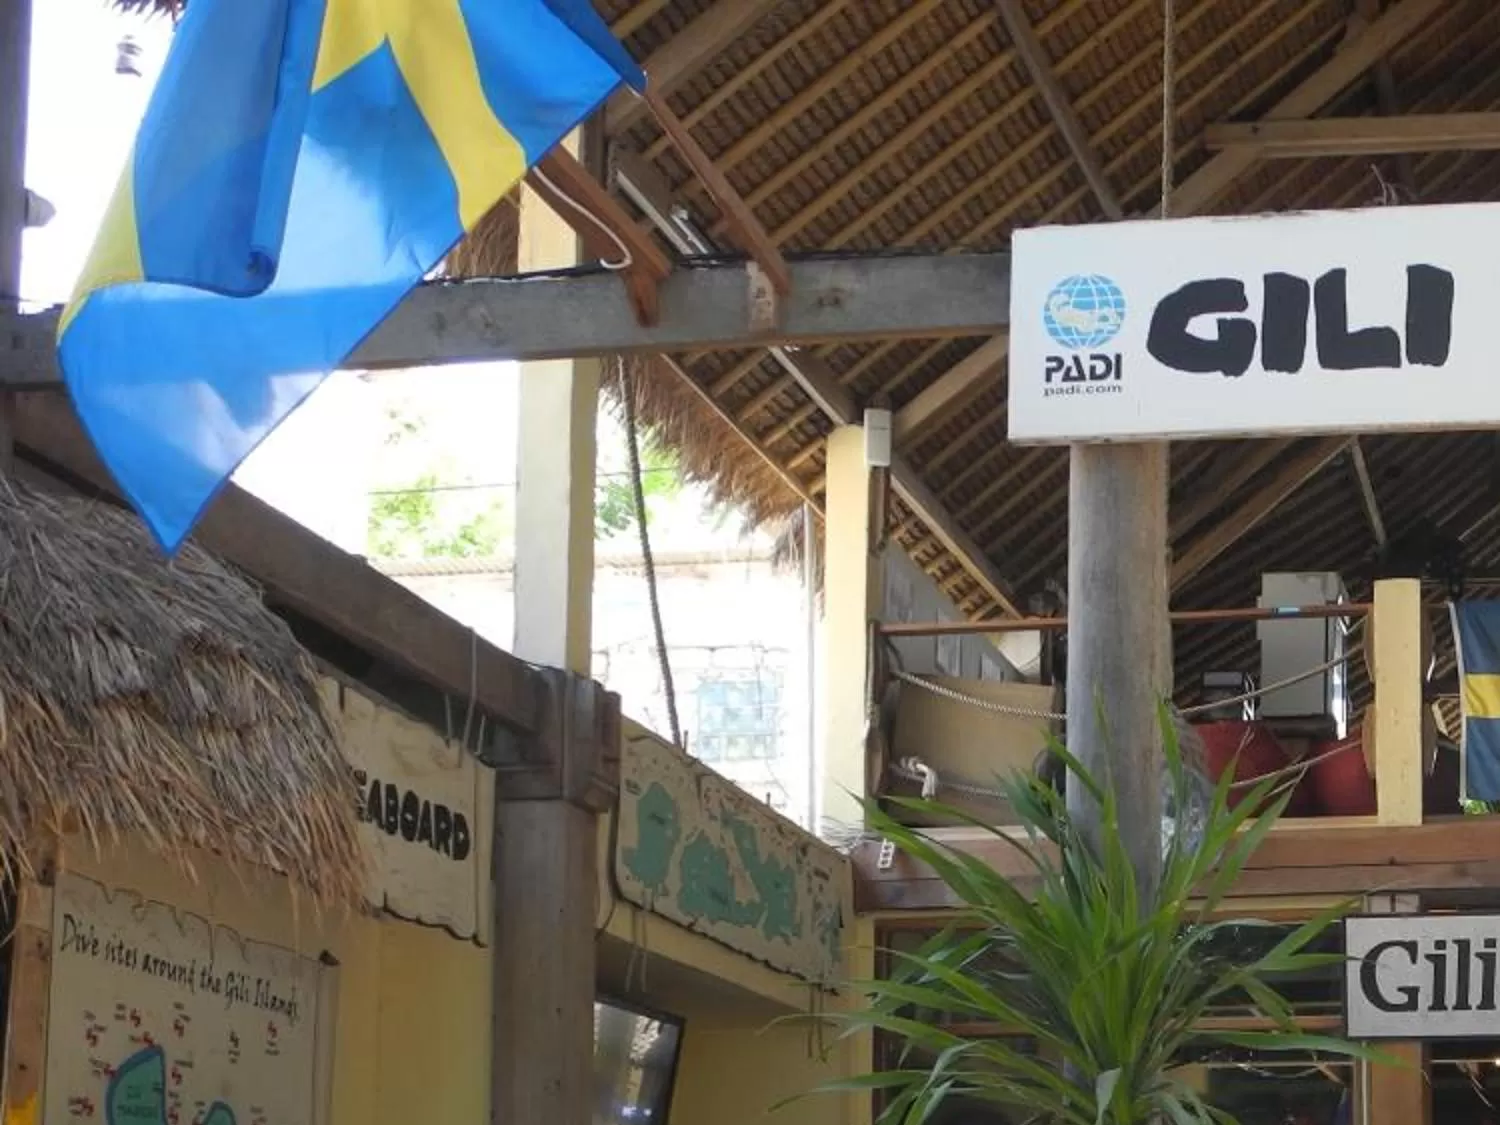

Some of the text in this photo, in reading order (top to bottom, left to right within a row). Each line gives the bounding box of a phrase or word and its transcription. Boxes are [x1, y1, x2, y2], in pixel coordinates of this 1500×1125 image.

[1146, 263, 1454, 377] GILI
[1043, 383, 1123, 397] padi.com
[1045, 352, 1123, 383] PADI
[353, 769, 471, 861] ABOARD
[60, 913, 100, 957] Dive
[142, 953, 197, 995] around
[200, 963, 221, 995] the
[225, 970, 252, 1011] Gili
[1359, 936, 1498, 1012] Gili
